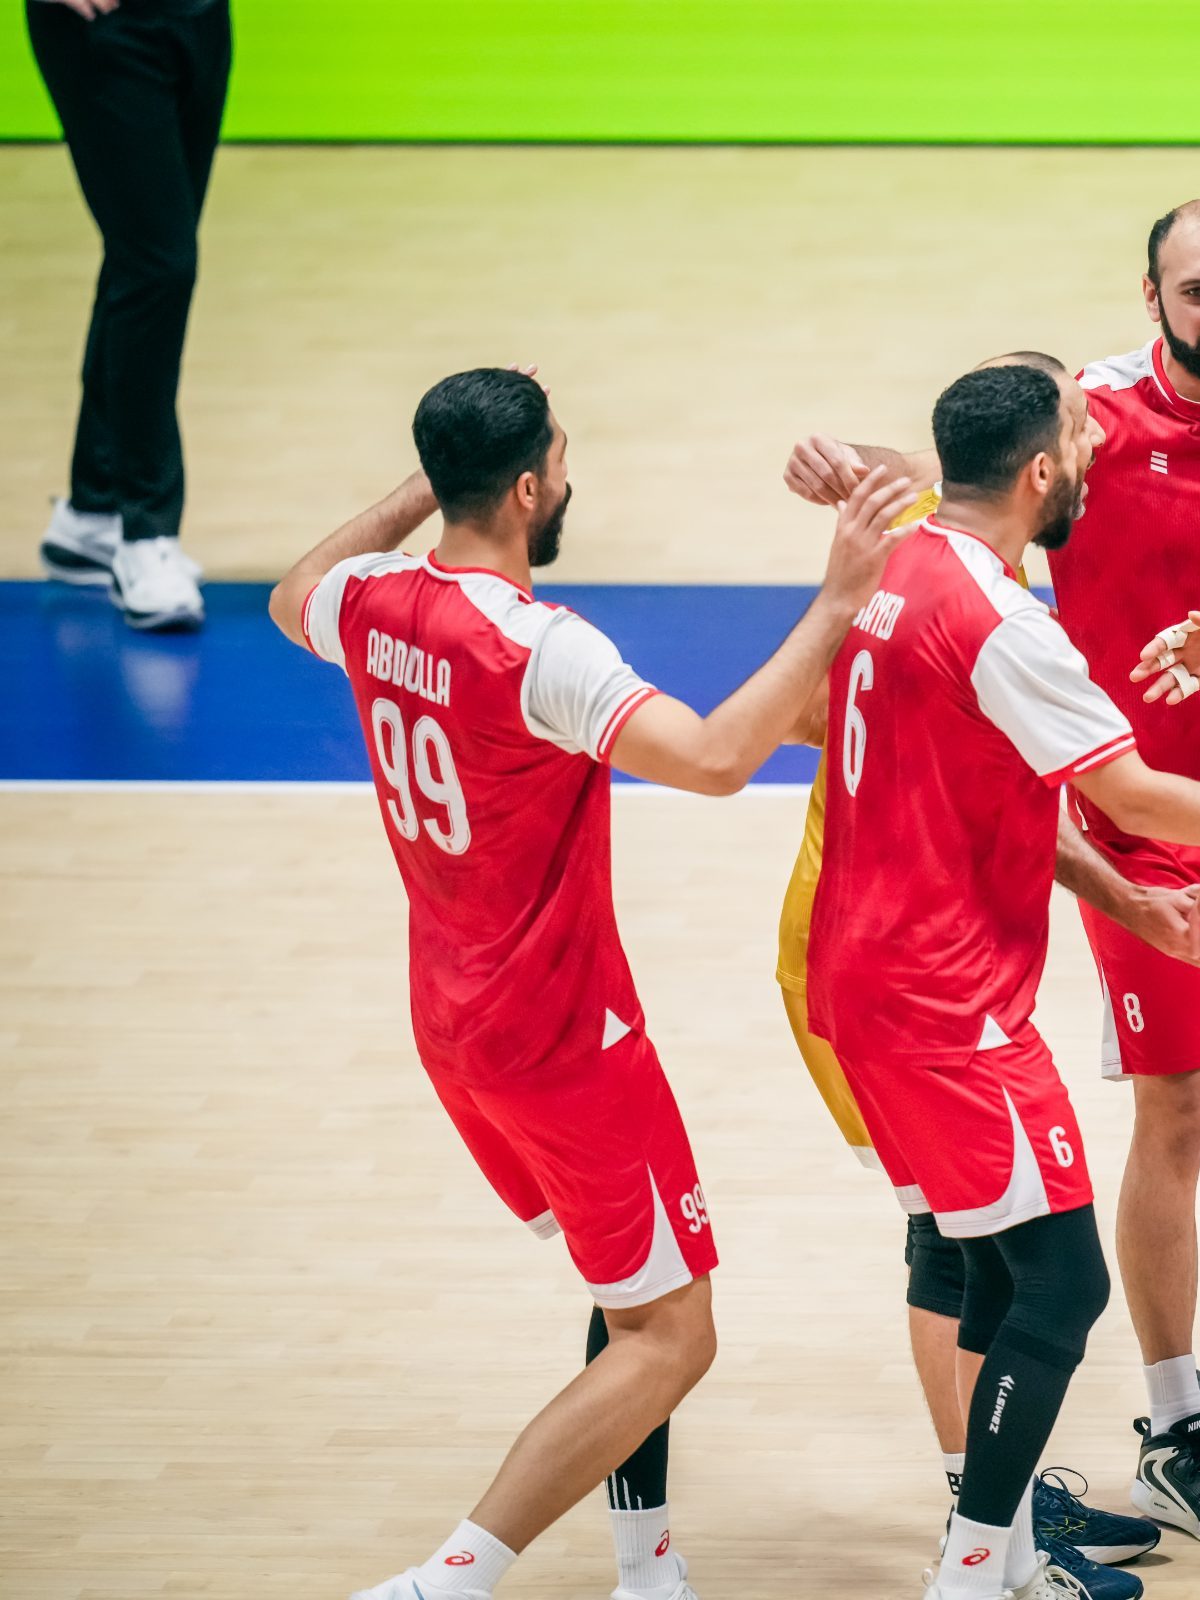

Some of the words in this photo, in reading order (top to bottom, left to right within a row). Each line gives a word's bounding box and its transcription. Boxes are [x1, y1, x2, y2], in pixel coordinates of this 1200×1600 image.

[843, 649, 874, 797] 6
[371, 697, 472, 856] 99
[1123, 992, 1145, 1033] 8
[1048, 1125, 1075, 1168] 6
[680, 1182, 709, 1234] 99
